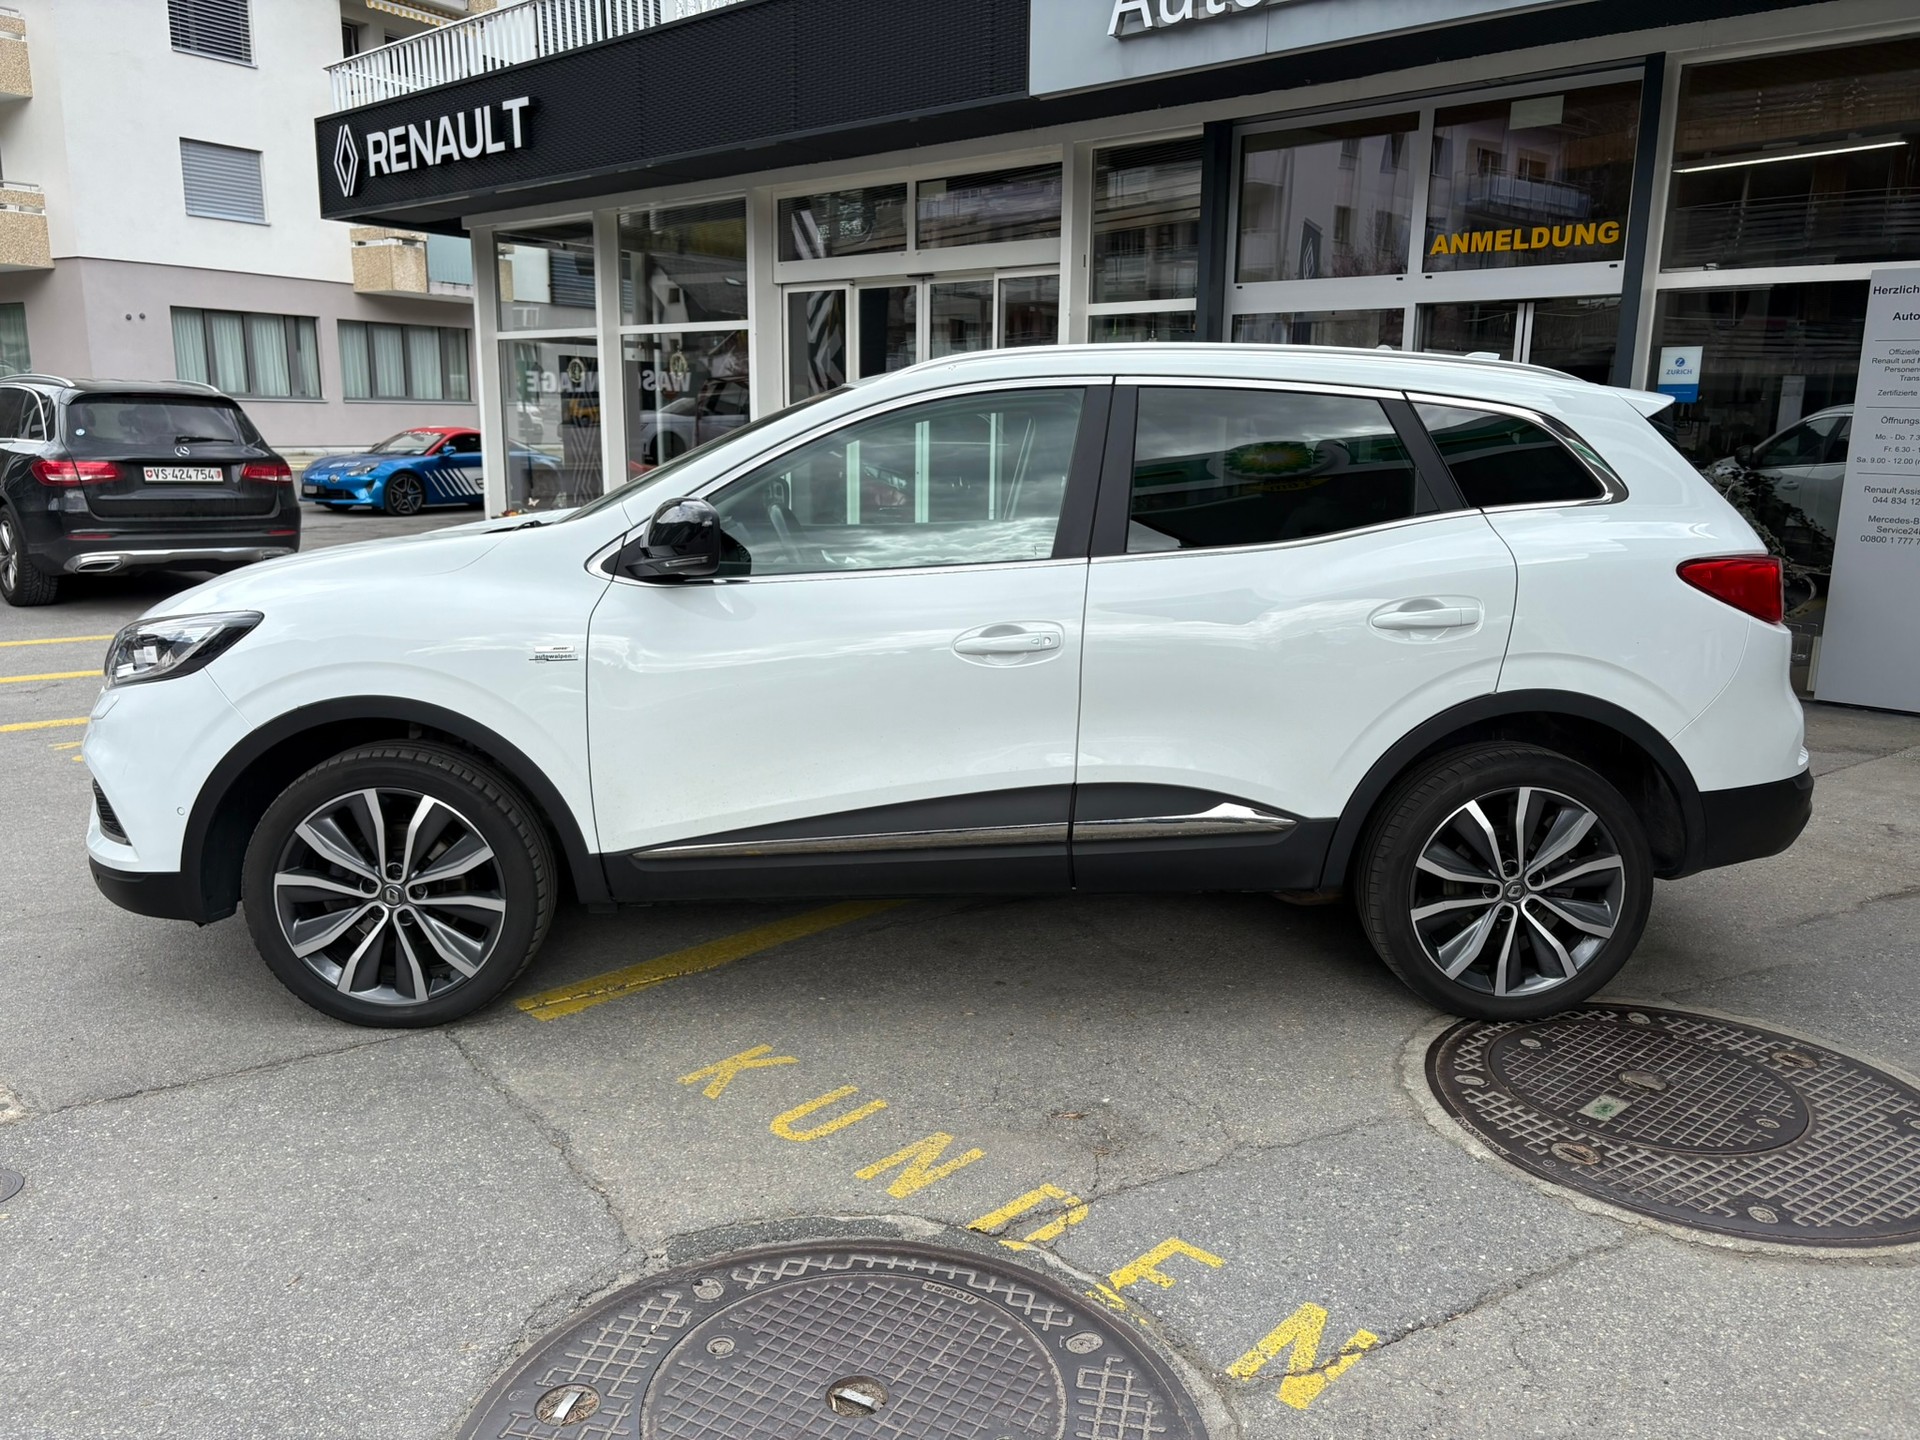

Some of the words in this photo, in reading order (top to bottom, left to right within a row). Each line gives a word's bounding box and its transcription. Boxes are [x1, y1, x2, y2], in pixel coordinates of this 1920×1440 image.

[366, 96, 530, 177] RENAULT
[1430, 221, 1620, 255] ANMELDUNG
[1873, 285, 1920, 295] Herzlich
[1892, 312, 1920, 321] Auto
[1864, 486, 1897, 494] Renault
[1872, 496, 1888, 504] 044
[1868, 515, 1920, 525] Mercedes-B
[1860, 535, 1887, 544] 00800
[1897, 537, 1913, 545] 777
[677, 1044, 1380, 1410] KUNDEN
